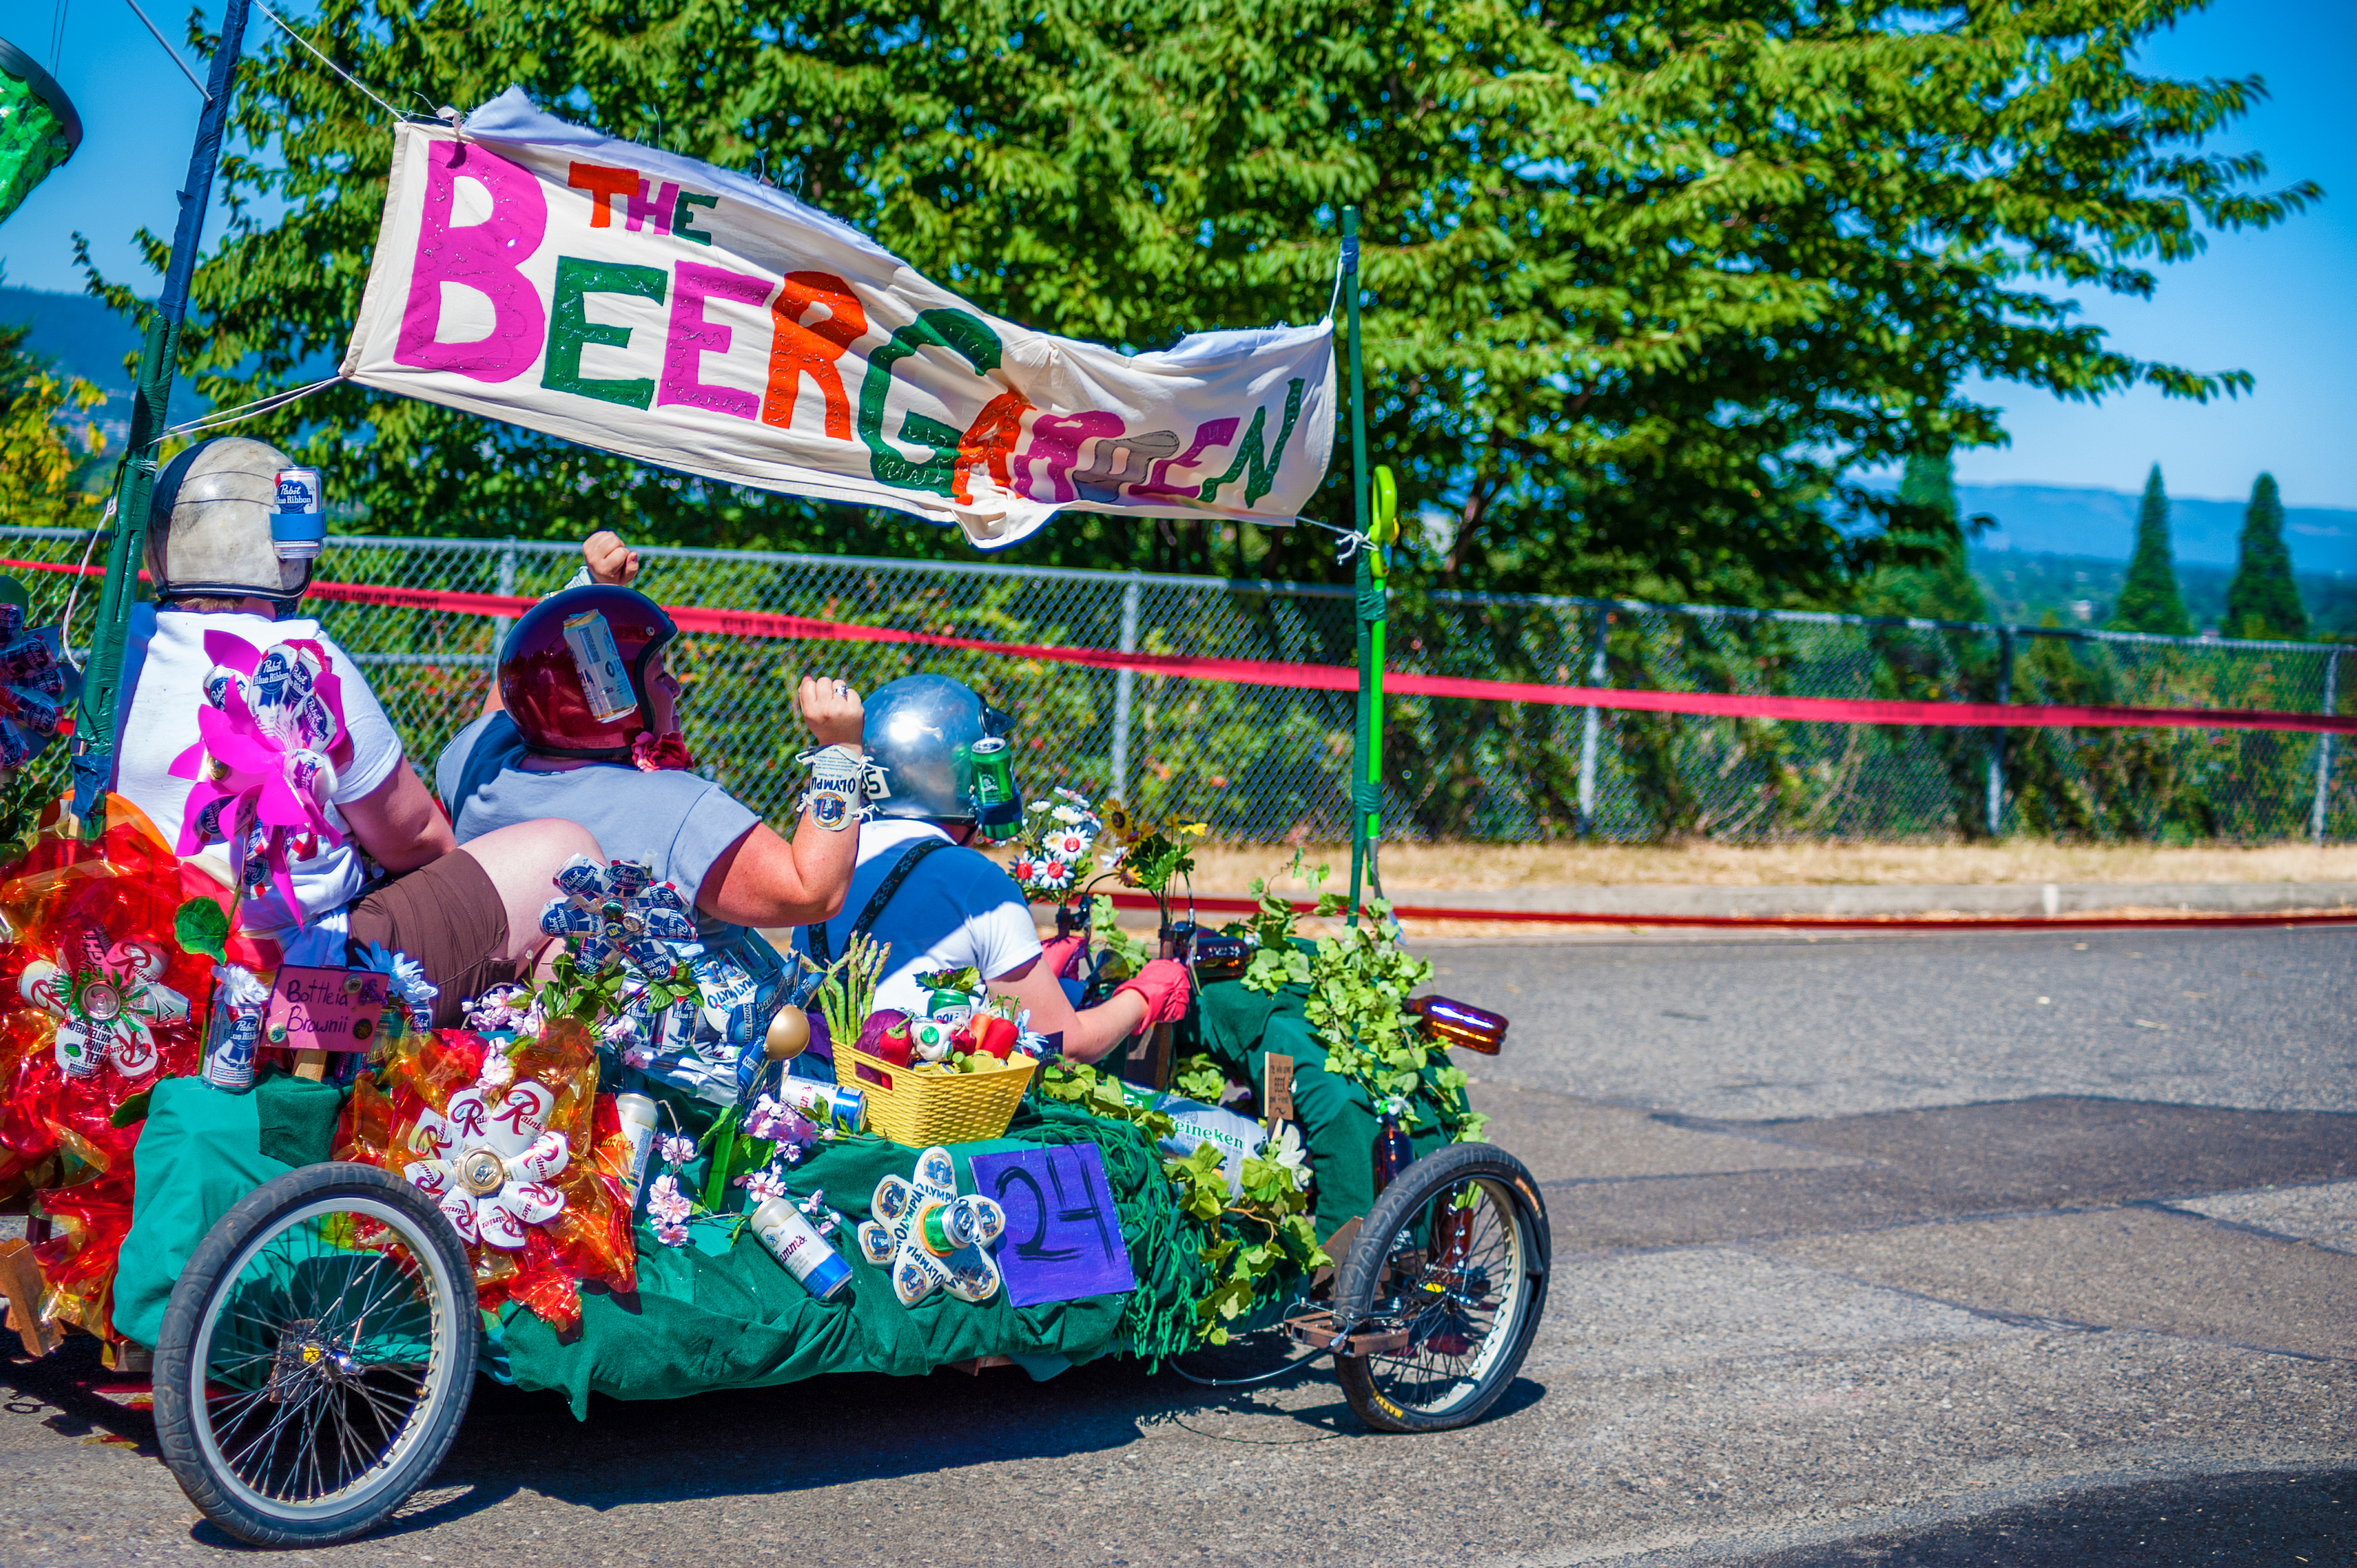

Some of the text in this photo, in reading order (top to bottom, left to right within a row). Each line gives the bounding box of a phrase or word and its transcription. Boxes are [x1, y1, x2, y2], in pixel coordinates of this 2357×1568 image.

[568, 160, 719, 245] THE
[280, 484, 301, 495] Pabst
[287, 496, 311, 504] Ribbon
[263, 659, 282, 673] Pabst
[292, 664, 308, 685] Pabst
[254, 671, 289, 685] Blue Ribbon
[308, 697, 323, 723] Pabst
[307, 714, 325, 740] Ribbon
[563, 870, 581, 886] Pabst
[577, 868, 596, 889] Ribbon
[605, 869, 647, 885] Blue Ribbon
[615, 867, 639, 878] Pabst
[649, 885, 660, 902] Blue
[549, 916, 560, 936] Pabst
[669, 911, 677, 929] Blue
[106, 942, 157, 983] Rainie
[578, 957, 597, 974] Pabst
[594, 957, 612, 968] Blue
[654, 951, 671, 965] Blue
[286, 979, 348, 1007] Bottleia
[631, 1009, 645, 1018] Blue
[743, 1003, 752, 1024] MOON
[758, 997, 775, 1012] BLUE
[236, 1020, 256, 1031] Pabst
[286, 1005, 348, 1033] Brownii
[225, 1029, 242, 1040] Blue
[83, 1038, 105, 1053] HIGH
[1170, 1117, 1243, 1150] eineken
[518, 1181, 559, 1221] Rainier
[996, 1152, 1117, 1268] 24
[481, 1205, 523, 1239] Rainier
[894, 1189, 925, 1240] OLYMPIA
[775, 1234, 807, 1264] amm's
[905, 1245, 944, 1287] OLYMPIA
